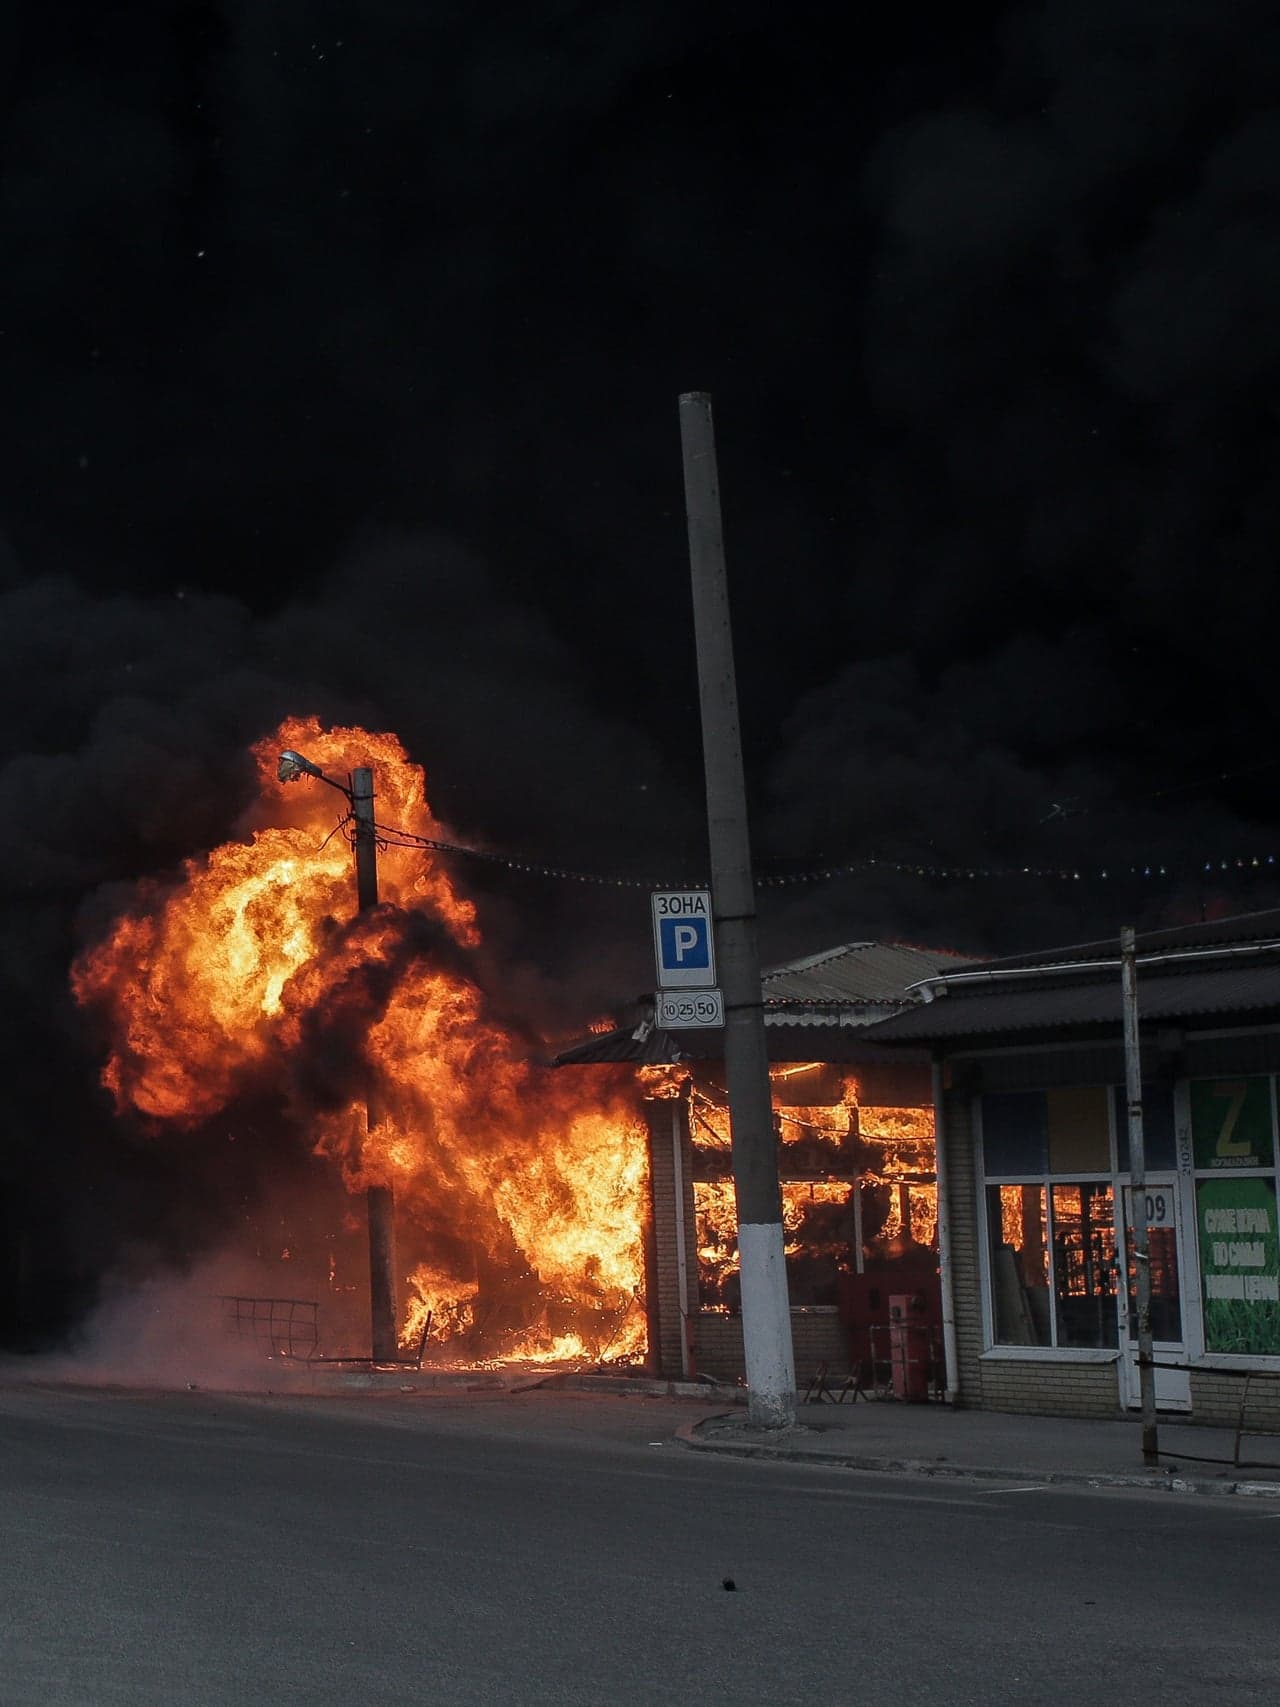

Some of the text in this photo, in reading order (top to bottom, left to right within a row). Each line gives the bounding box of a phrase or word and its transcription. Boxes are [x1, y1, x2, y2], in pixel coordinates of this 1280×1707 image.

[657, 896, 707, 915] ЗОНА
[674, 925, 698, 962] P
[665, 1002, 714, 1016] 10 25 50
